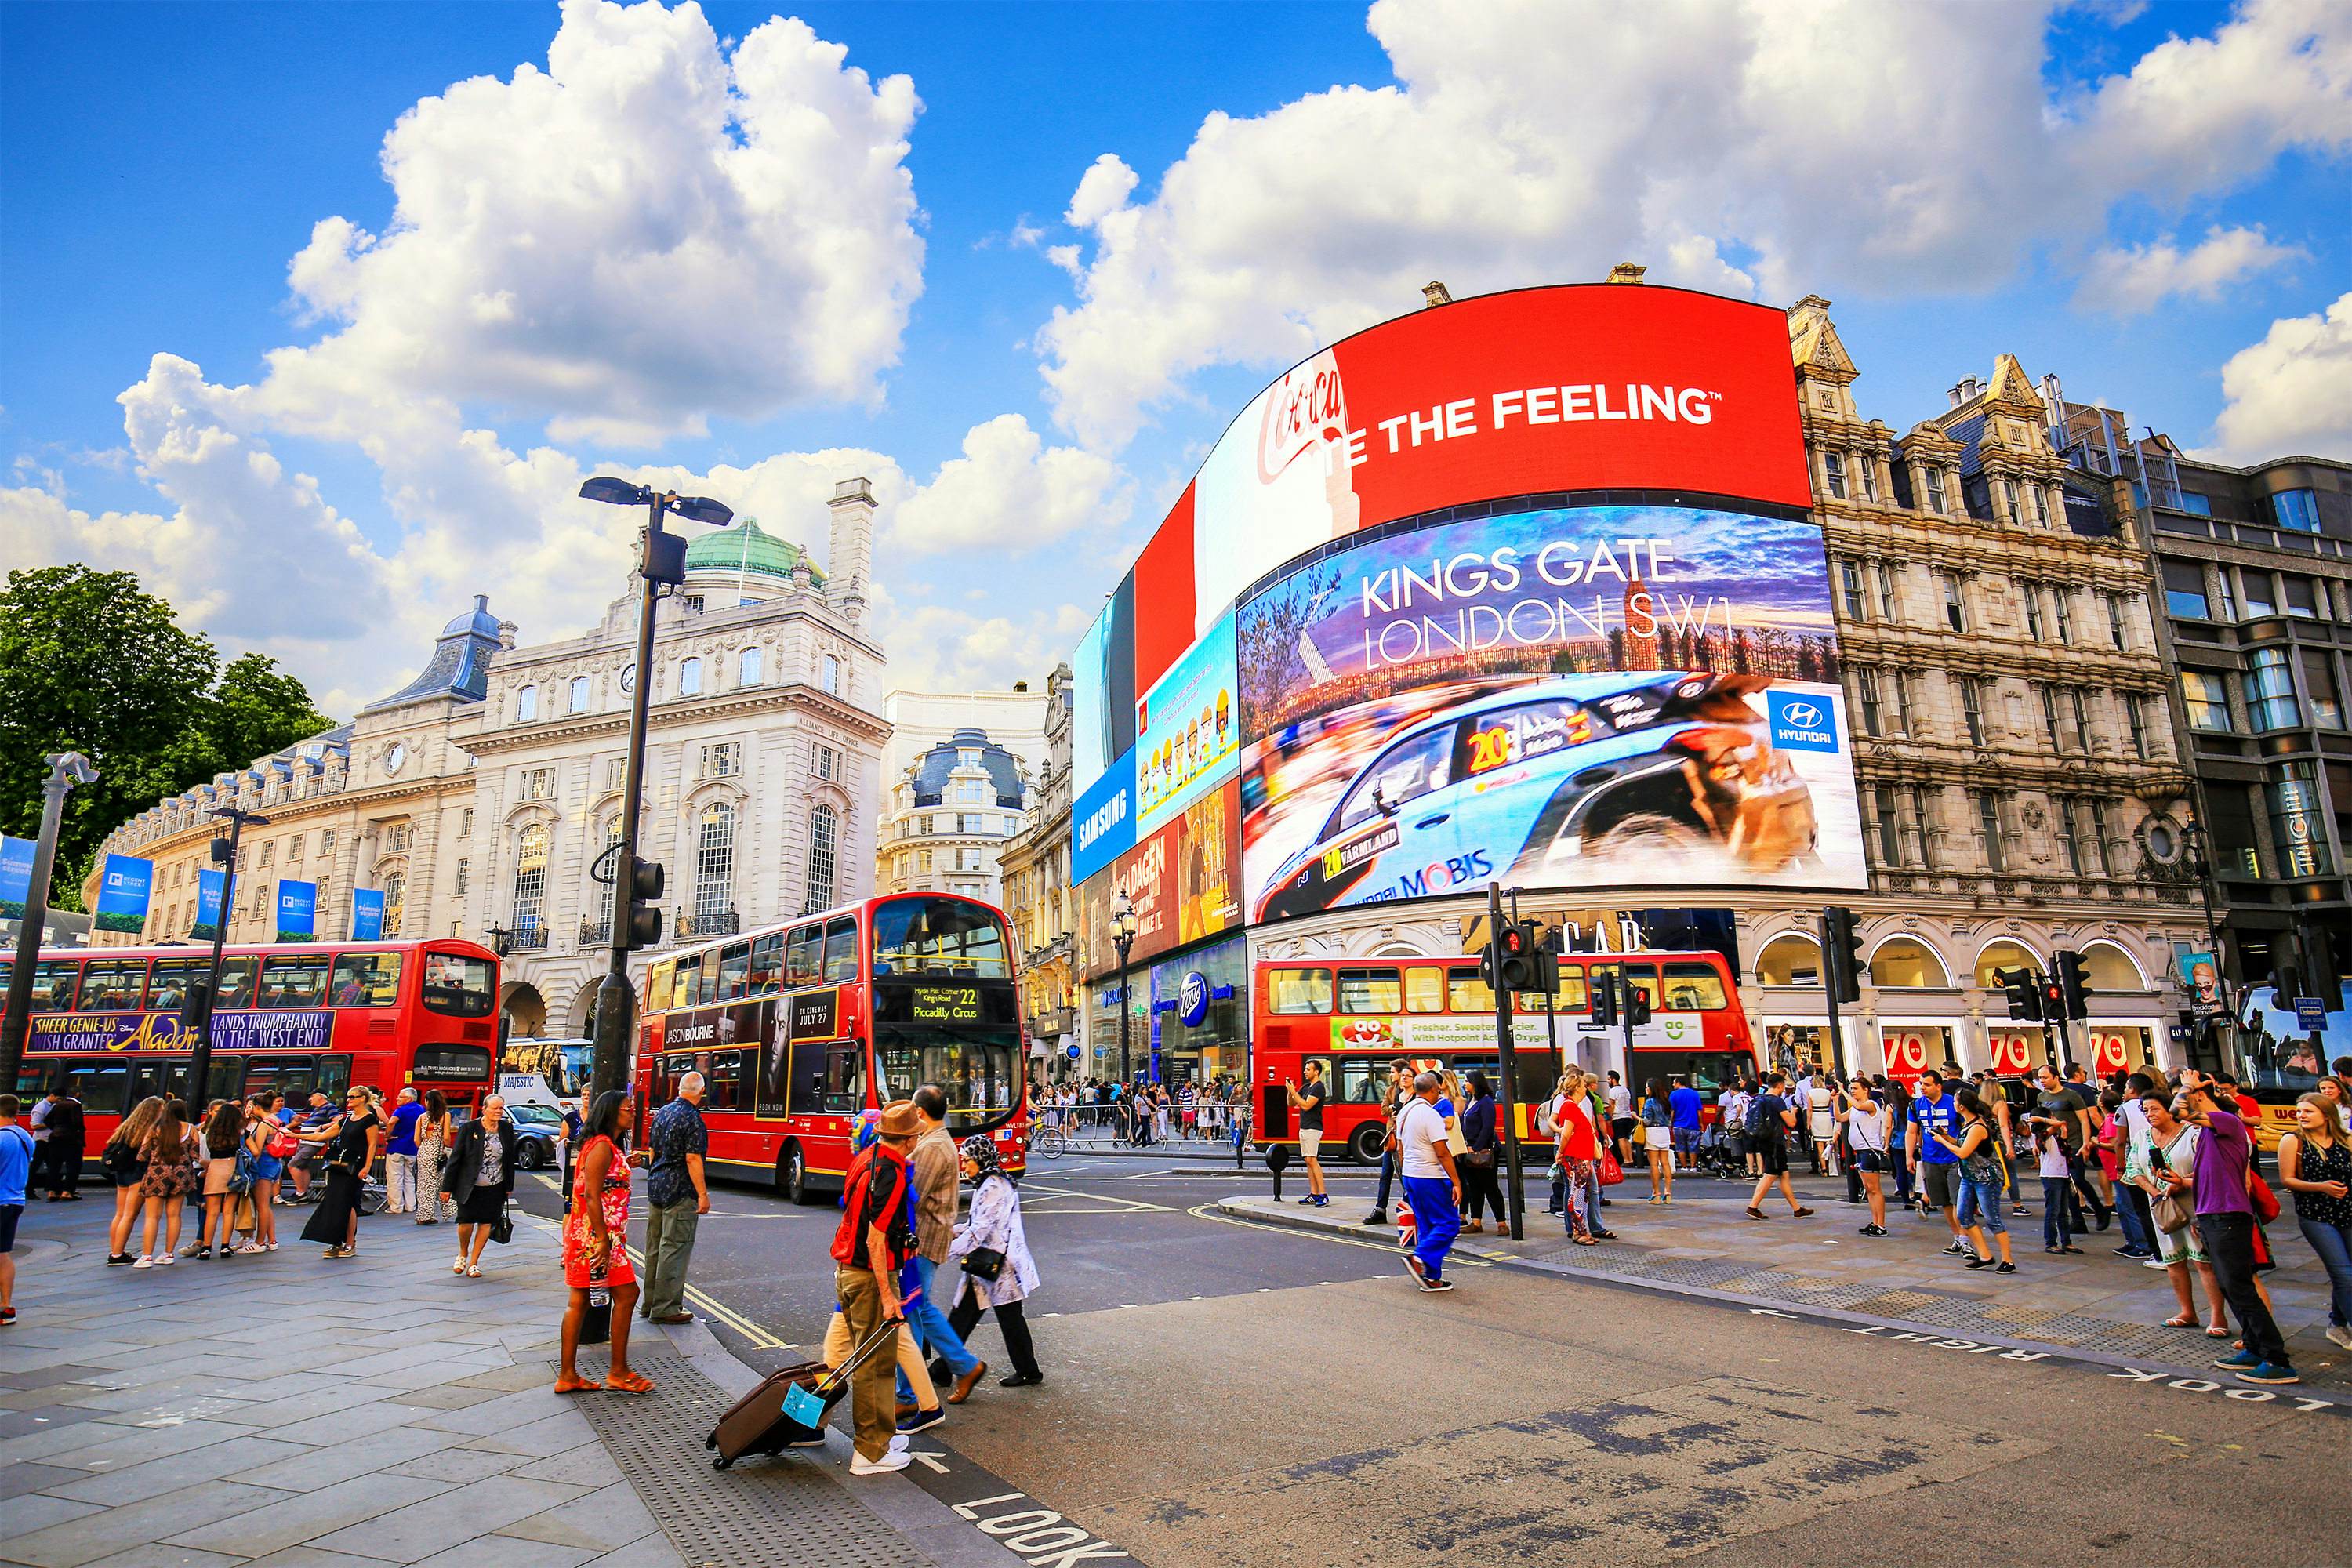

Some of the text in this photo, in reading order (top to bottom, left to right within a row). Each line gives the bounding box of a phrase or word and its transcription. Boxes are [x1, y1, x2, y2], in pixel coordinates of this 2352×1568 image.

[1378, 397, 1477, 453] THE
[1362, 539, 1676, 618] KINGS GATE
[1364, 593, 1734, 670] LONDON SW1
[1468, 727, 1510, 772] 20
[1778, 728, 1831, 744] HYUNDAI
[1079, 788, 1127, 852] SAMSUNG
[1131, 835, 1165, 896] DAGEN
[1324, 848, 1342, 880] 20
[1399, 848, 1494, 898] MOBIS
[1140, 914, 1154, 936] MAKE
[923, 995, 938, 1004] King's
[960, 989, 976, 1004] 22
[1108, 985, 1132, 1005] BARCLS
[1179, 979, 1201, 1018] Boots
[248, 1013, 327, 1029] TRIUMPHANTLY
[799, 1013, 827, 1025] JULY 27
[807, 1005, 827, 1014] CINEMAS
[914, 1007, 977, 1020] Piccadilly Circus
[212, 1030, 225, 1047] IN
[230, 1029, 255, 1047] THE
[259, 1029, 293, 1047] WEST
[1412, 1023, 1452, 1032] Fresher.
[1413, 1033, 1436, 1042] With
[1437, 1033, 1479, 1044] Hotpoint
[1482, 1033, 1499, 1042] Act
[1884, 1033, 1927, 1069] 70
[1990, 1034, 2031, 1069] 70
[504, 1076, 534, 1087] MAJESTIC
[1842, 1327, 2335, 1412] LOOK RIGHT
[951, 1493, 1129, 1568] LOOK
